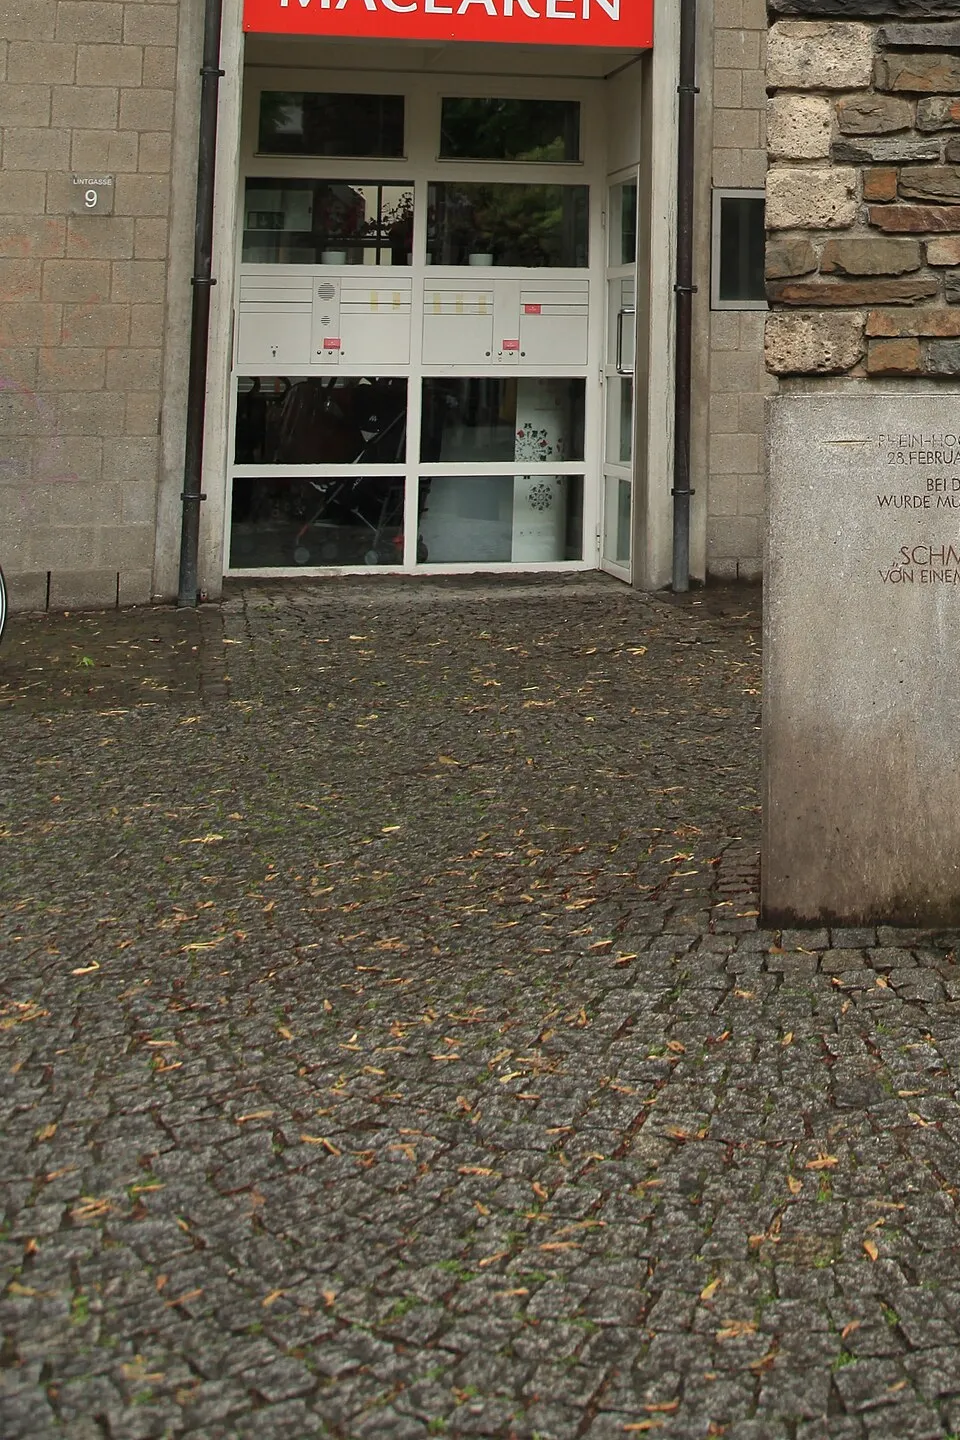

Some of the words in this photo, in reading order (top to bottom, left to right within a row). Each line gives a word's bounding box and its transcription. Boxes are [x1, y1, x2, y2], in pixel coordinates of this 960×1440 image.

[85, 189, 97, 208] 9
[926, 478, 947, 492] BEI
[877, 495, 931, 509] WURDE
[878, 569, 914, 584] VON
